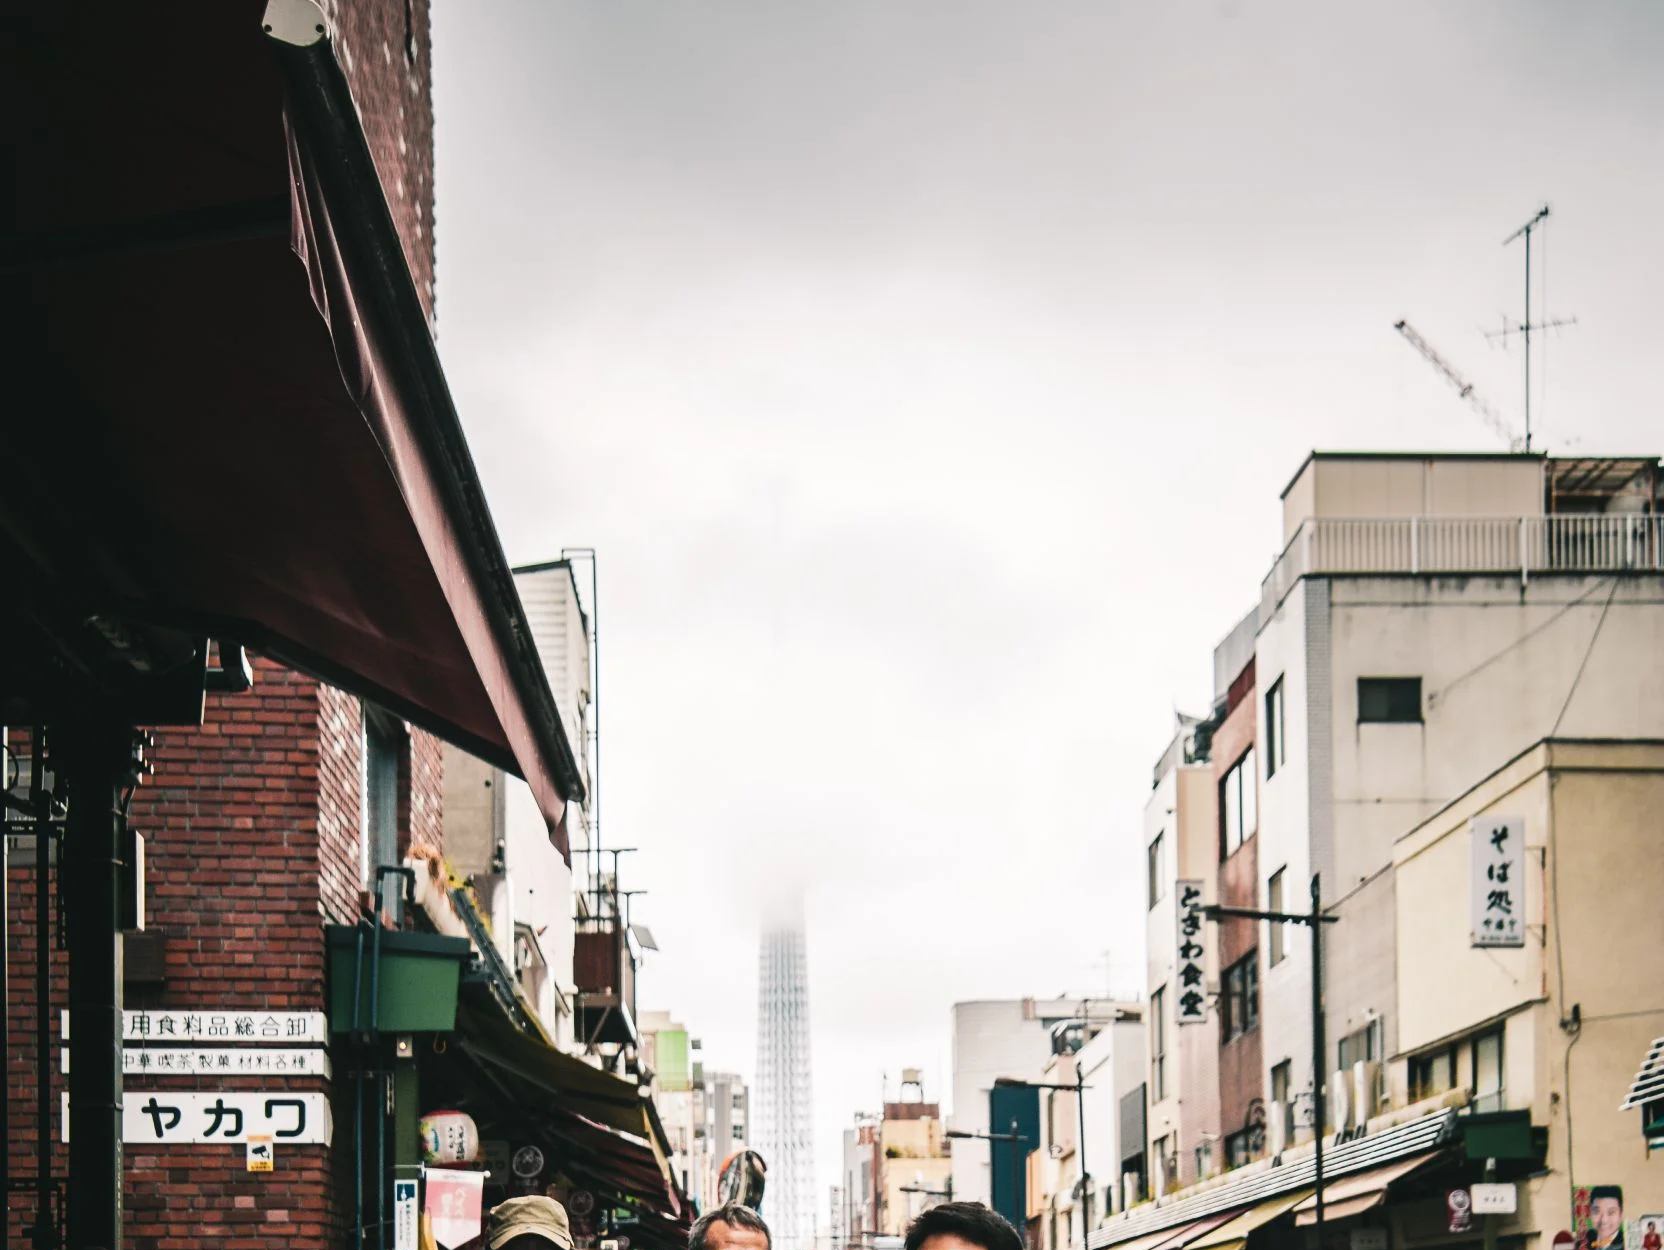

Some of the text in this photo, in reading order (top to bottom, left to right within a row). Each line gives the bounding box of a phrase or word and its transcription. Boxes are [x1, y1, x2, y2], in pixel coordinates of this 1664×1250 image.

[1486, 824, 1515, 914] そば処
[1179, 886, 1205, 1016] ときわ食堂
[122, 1014, 307, 1038] 用食料品総合卸
[141, 1097, 306, 1138] ヤカワ
